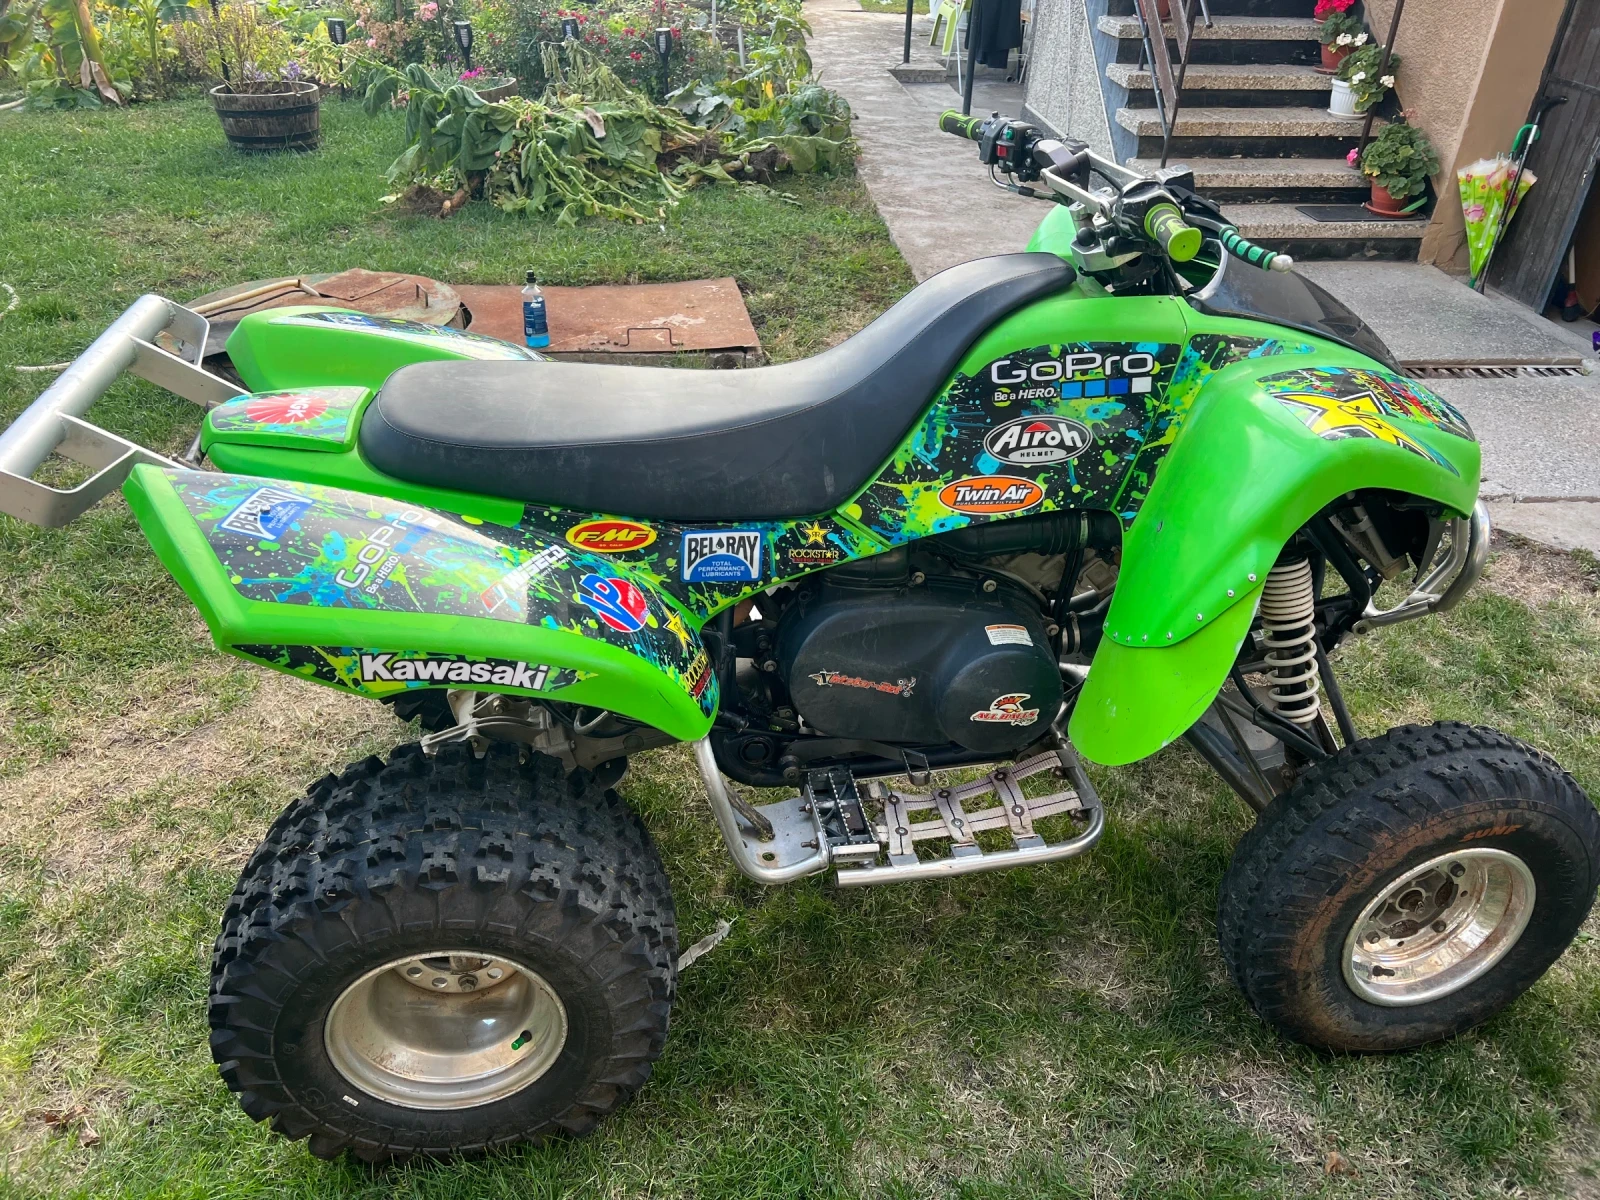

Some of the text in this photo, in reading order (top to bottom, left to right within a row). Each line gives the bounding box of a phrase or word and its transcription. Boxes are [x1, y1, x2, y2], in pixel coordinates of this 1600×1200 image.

[991, 353, 1154, 384] GoPro
[994, 388, 1057, 402] Be a HERO.
[992, 422, 1083, 454] Airoh
[1020, 450, 1055, 458] HELMET
[955, 484, 1033, 501] Twin Air
[335, 510, 423, 588] GoPro
[574, 529, 651, 543] FMF
[687, 535, 759, 569] BEL RAY
[366, 582, 379, 594] Be
[377, 556, 400, 578] HERO.
[361, 654, 549, 690] Kawasaki
